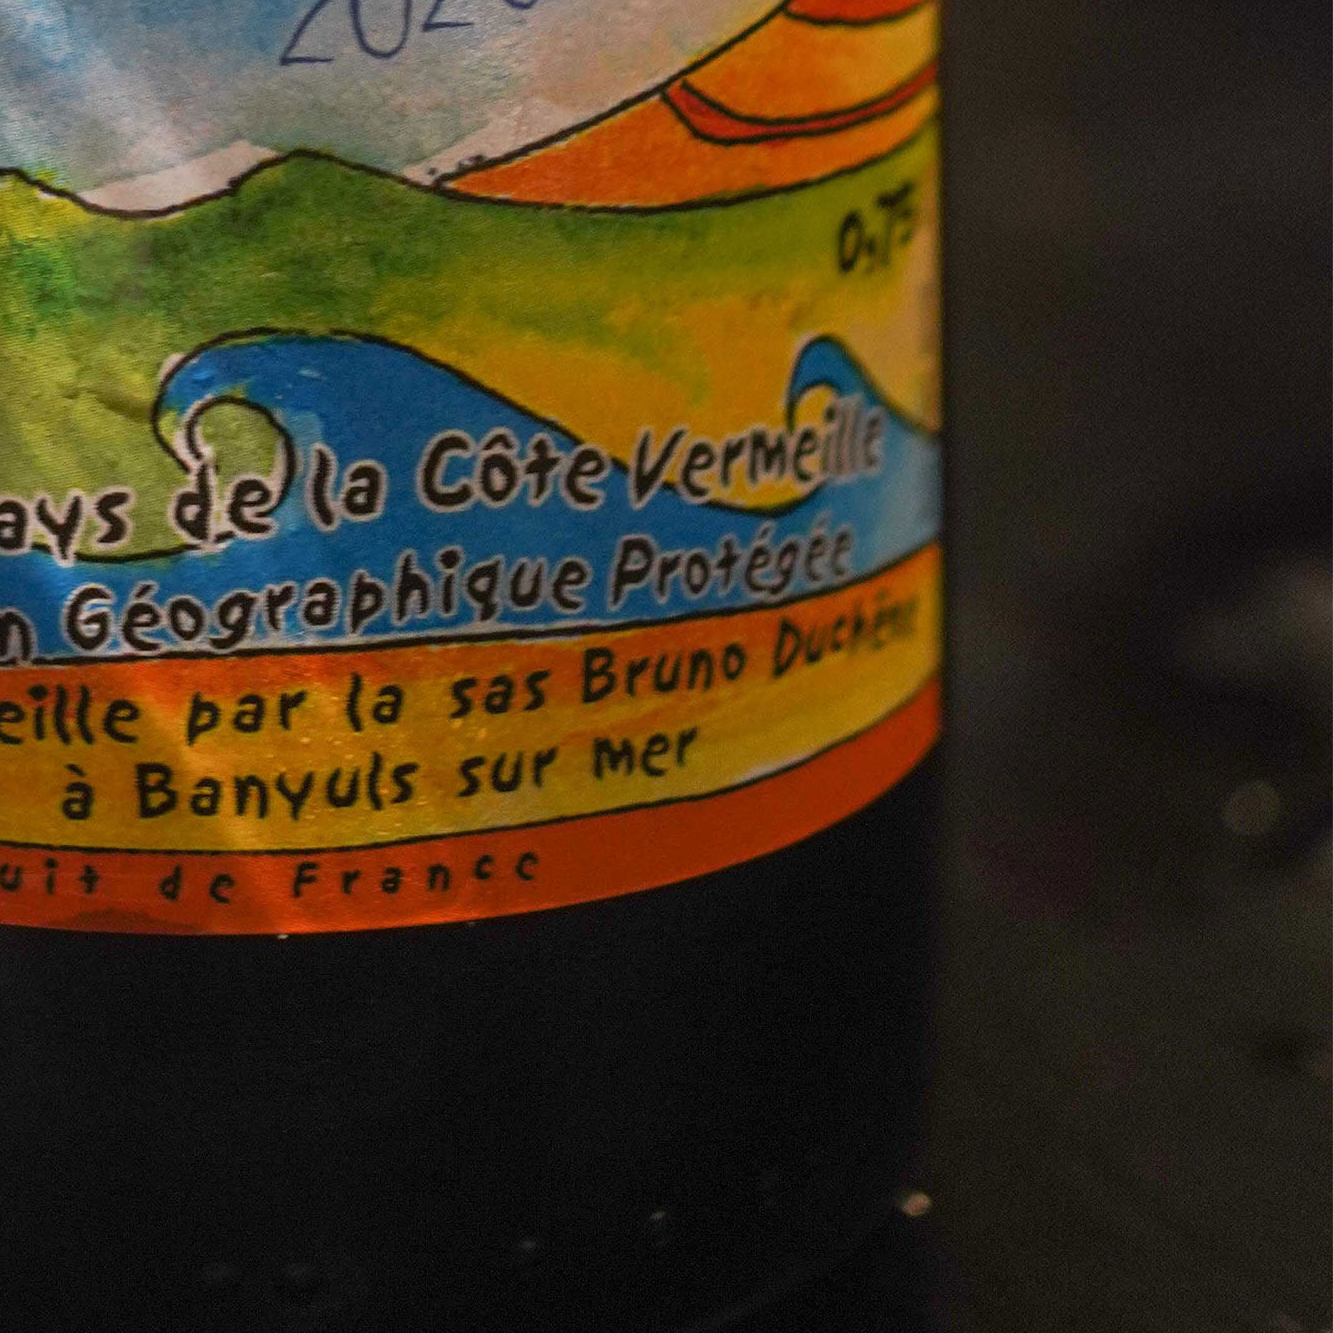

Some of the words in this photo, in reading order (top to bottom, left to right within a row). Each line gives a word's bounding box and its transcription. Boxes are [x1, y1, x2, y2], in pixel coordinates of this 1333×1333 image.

[171, 461, 277, 541] de
[311, 443, 387, 529] la
[417, 427, 609, 513] Côte
[630, 395, 885, 507] Vermeille
[65, 549, 593, 653] Géographique
[613, 516, 854, 607] Protégée
[183, 683, 307, 747] par
[345, 671, 405, 733] la
[447, 667, 547, 721] sas
[579, 637, 749, 705] Bruno
[58, 764, 94, 821] à
[137, 751, 419, 821] Banyuls
[459, 749, 557, 797] sur
[591, 723, 701, 779] mer
[158, 866, 235, 903] de
[291, 847, 541, 901] France
